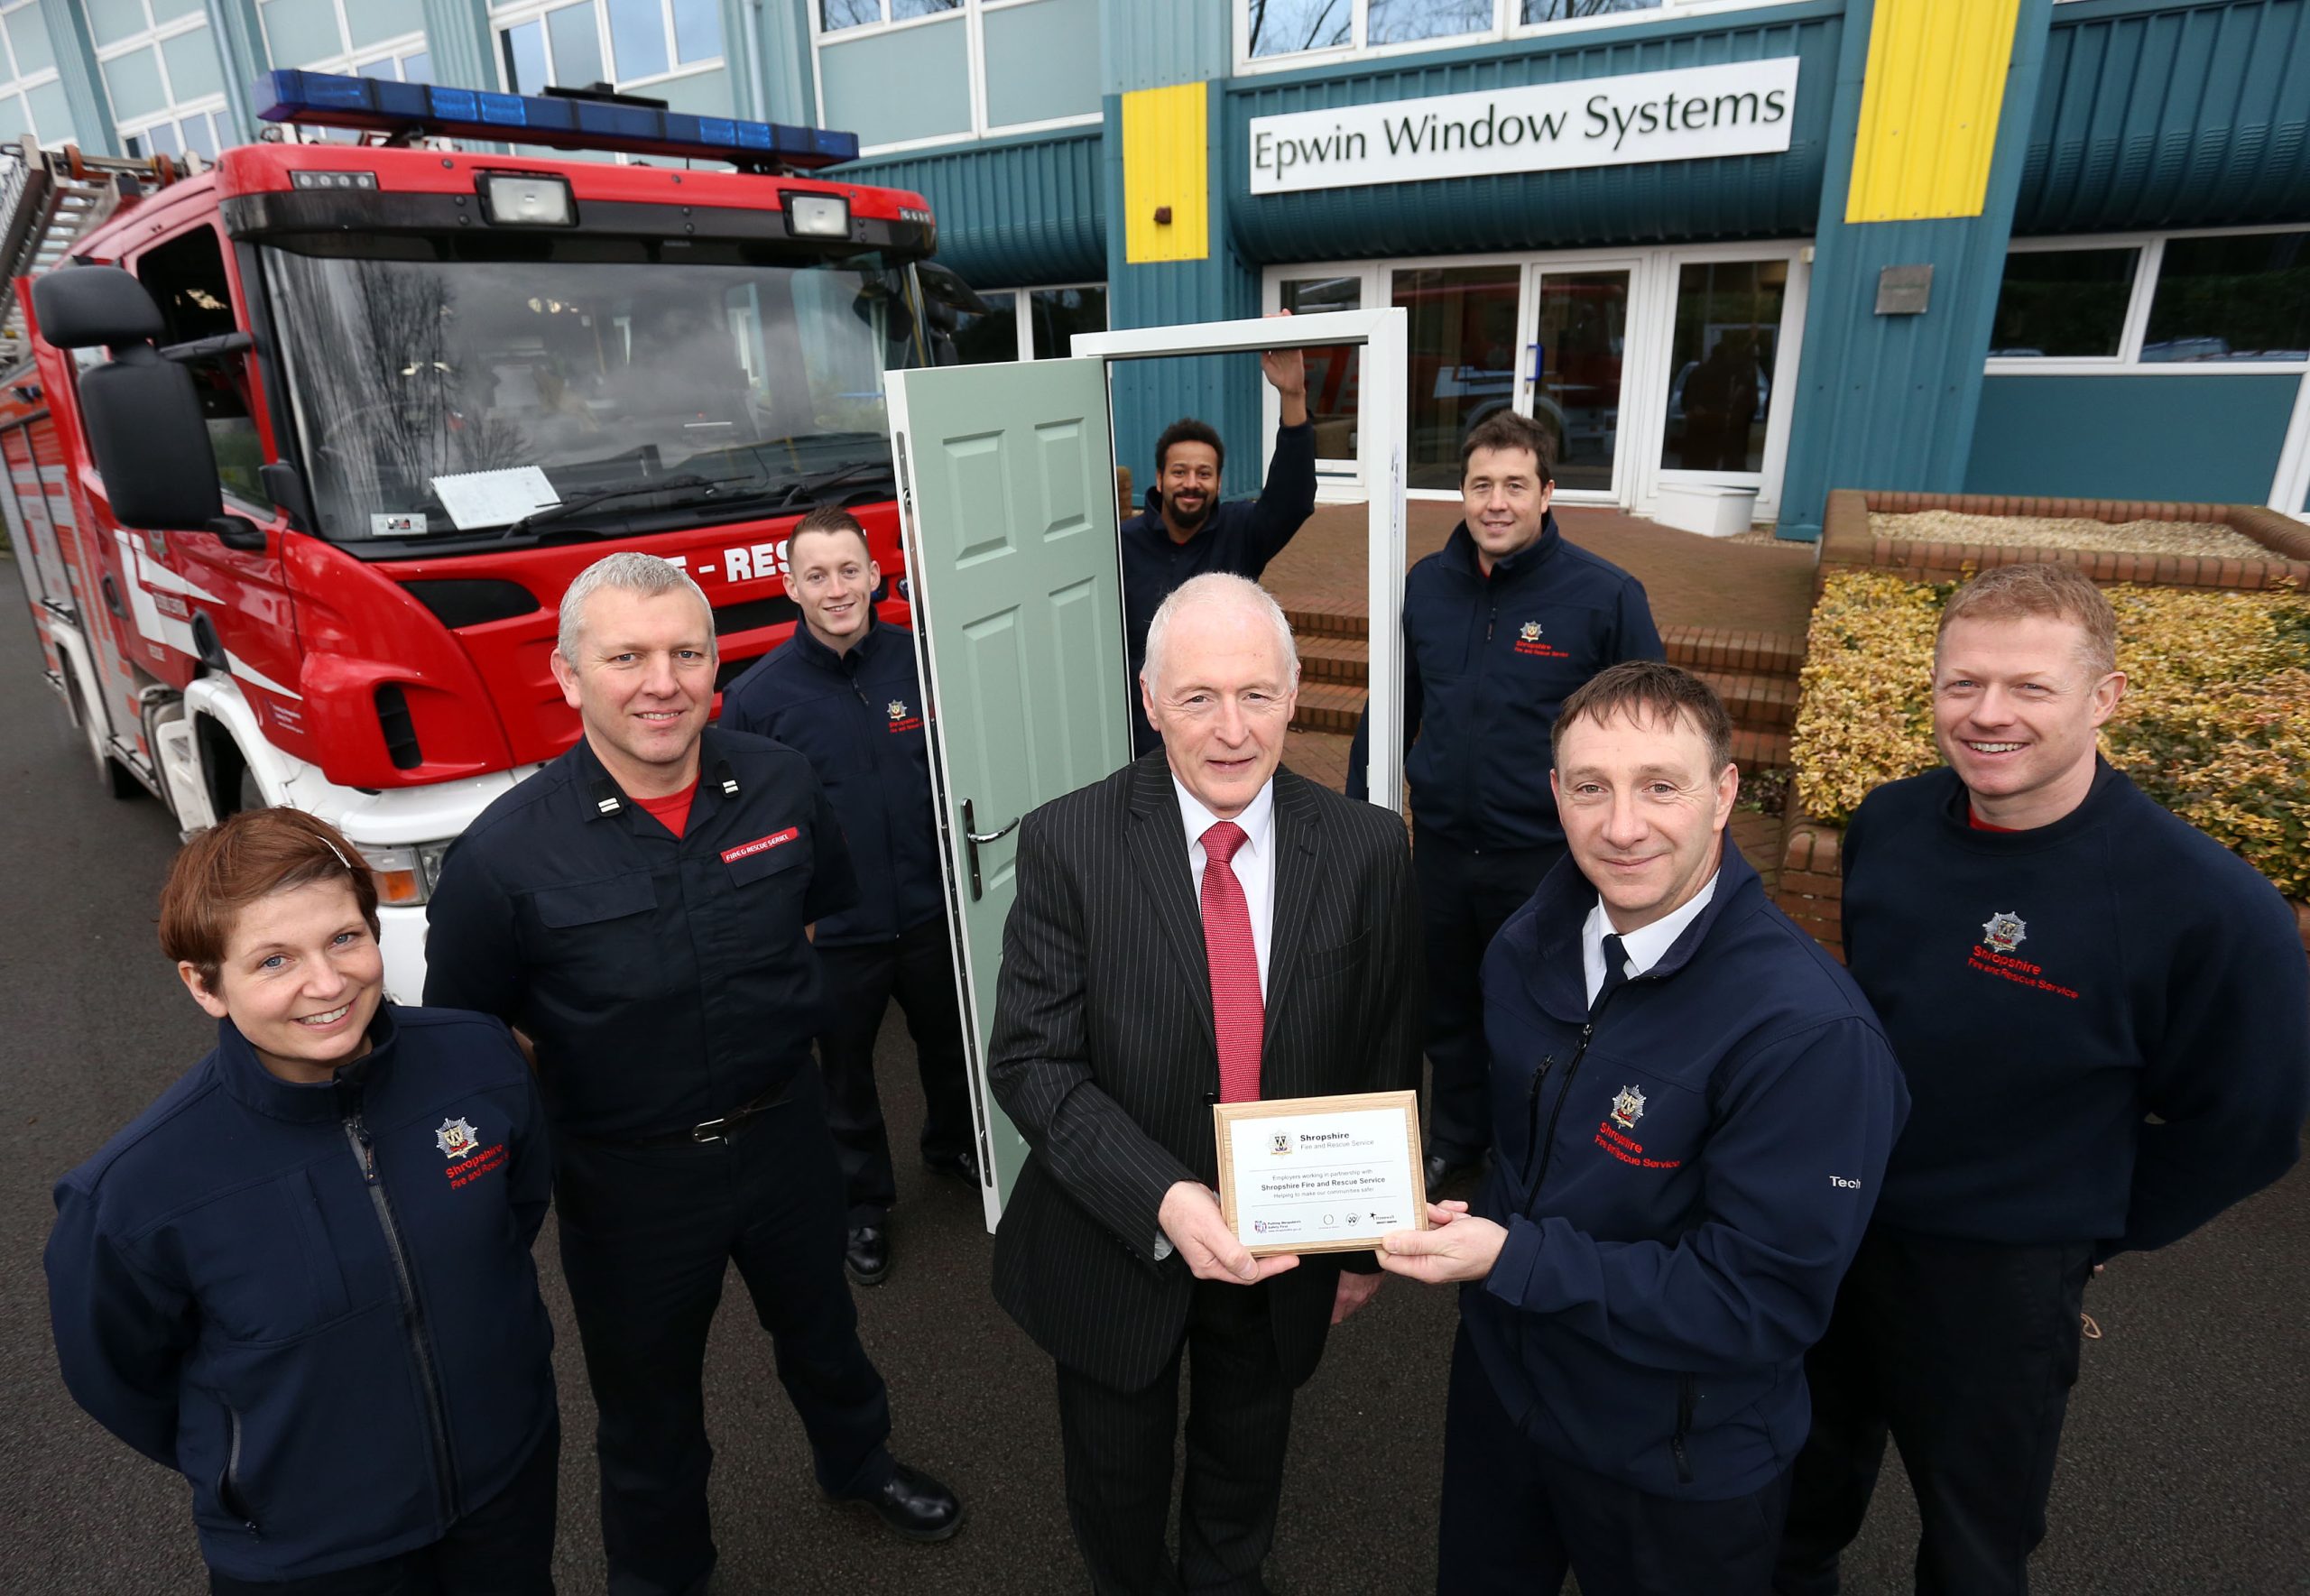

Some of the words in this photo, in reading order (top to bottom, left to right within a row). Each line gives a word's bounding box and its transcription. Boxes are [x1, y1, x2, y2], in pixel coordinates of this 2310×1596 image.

[1254, 125, 1367, 180] Epwin
[1383, 103, 1566, 156] Window
[1585, 88, 1786, 152] Systems
[725, 851, 742, 862] FIRE
[746, 841, 769, 853] RESCUE
[1973, 945, 2042, 975] Shropshire
[2000, 968, 2037, 987] Rescue
[2037, 979, 2080, 1000] Service
[1300, 1132, 1350, 1142] Shropshire
[446, 1144, 503, 1179] Shropshire
[1642, 1158, 1681, 1168] Service
[1261, 1183, 1300, 1192] Shropshire
